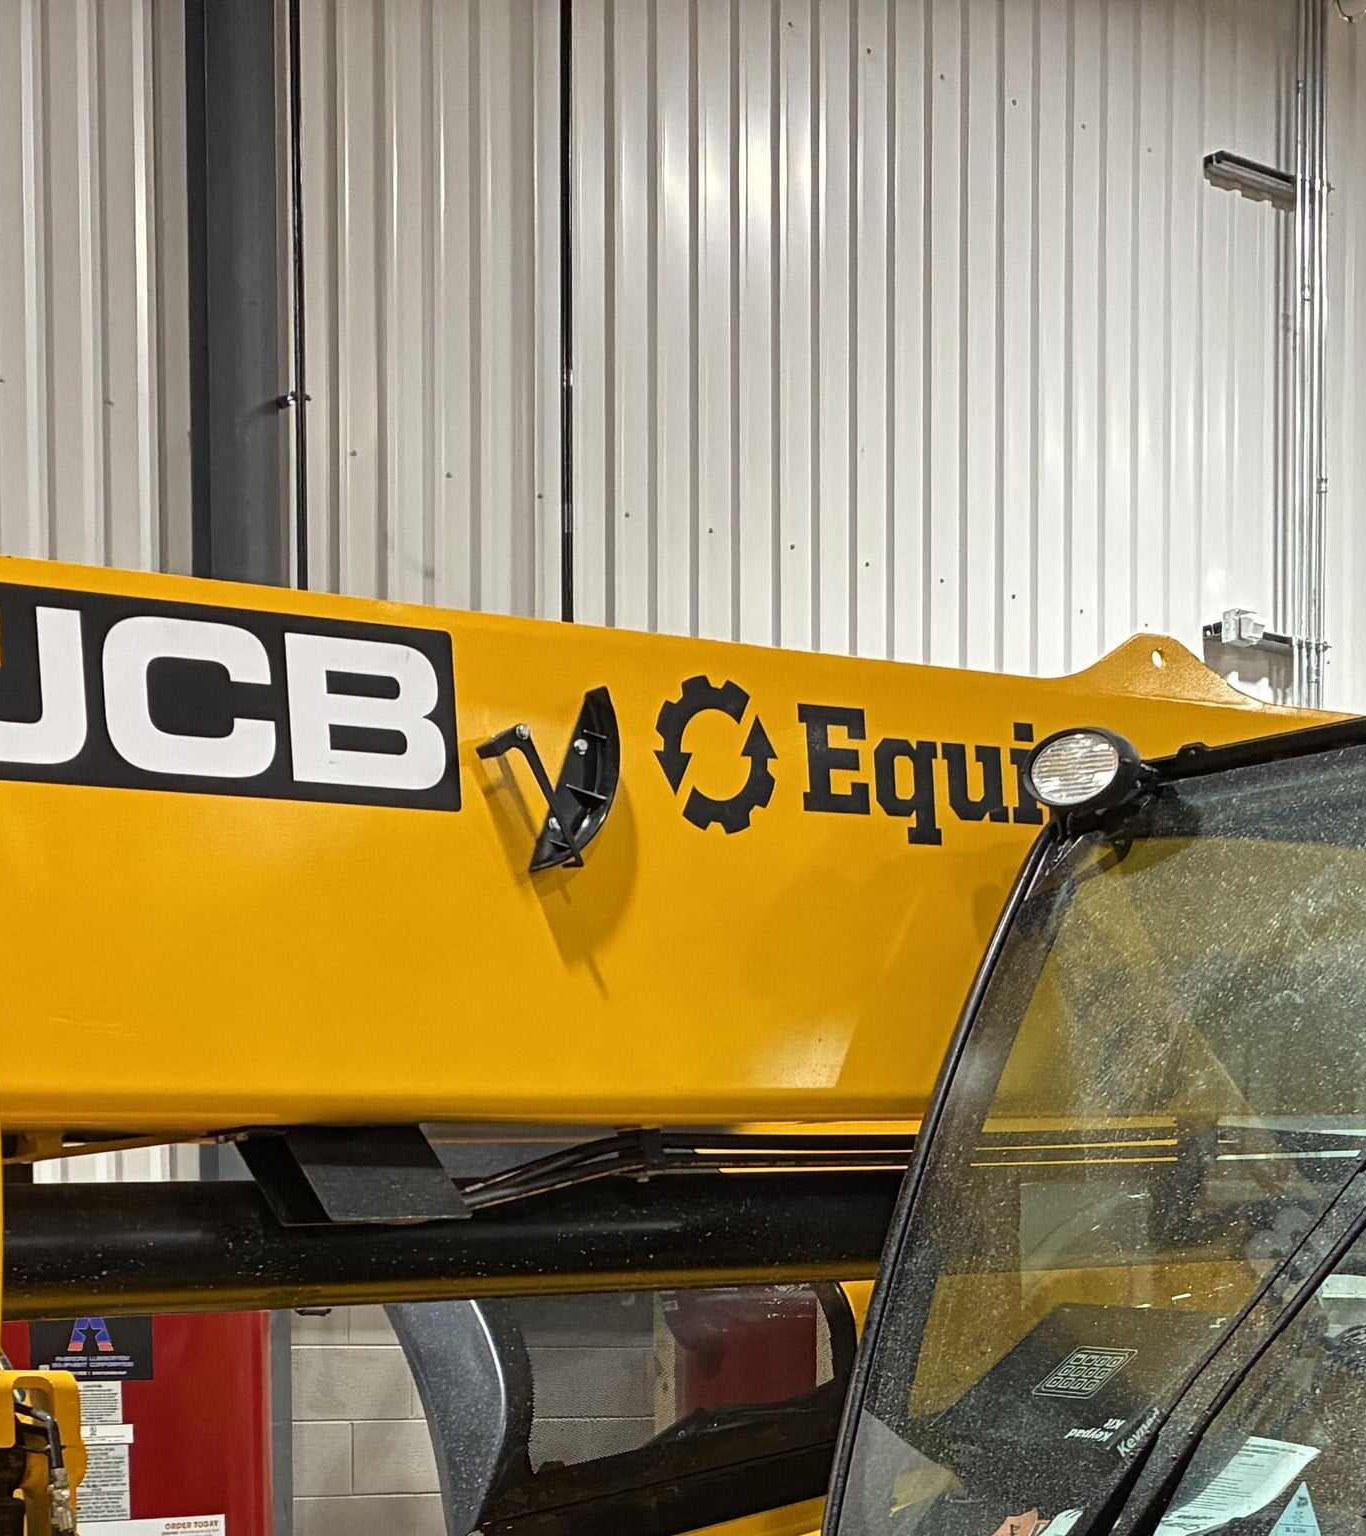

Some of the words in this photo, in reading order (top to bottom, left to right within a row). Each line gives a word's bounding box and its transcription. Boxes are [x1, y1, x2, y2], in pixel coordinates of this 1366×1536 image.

[1063, 1428, 1113, 1442] Keypad
[165, 1522, 192, 1530] ORDER
[194, 1520, 219, 1528] TODAY
